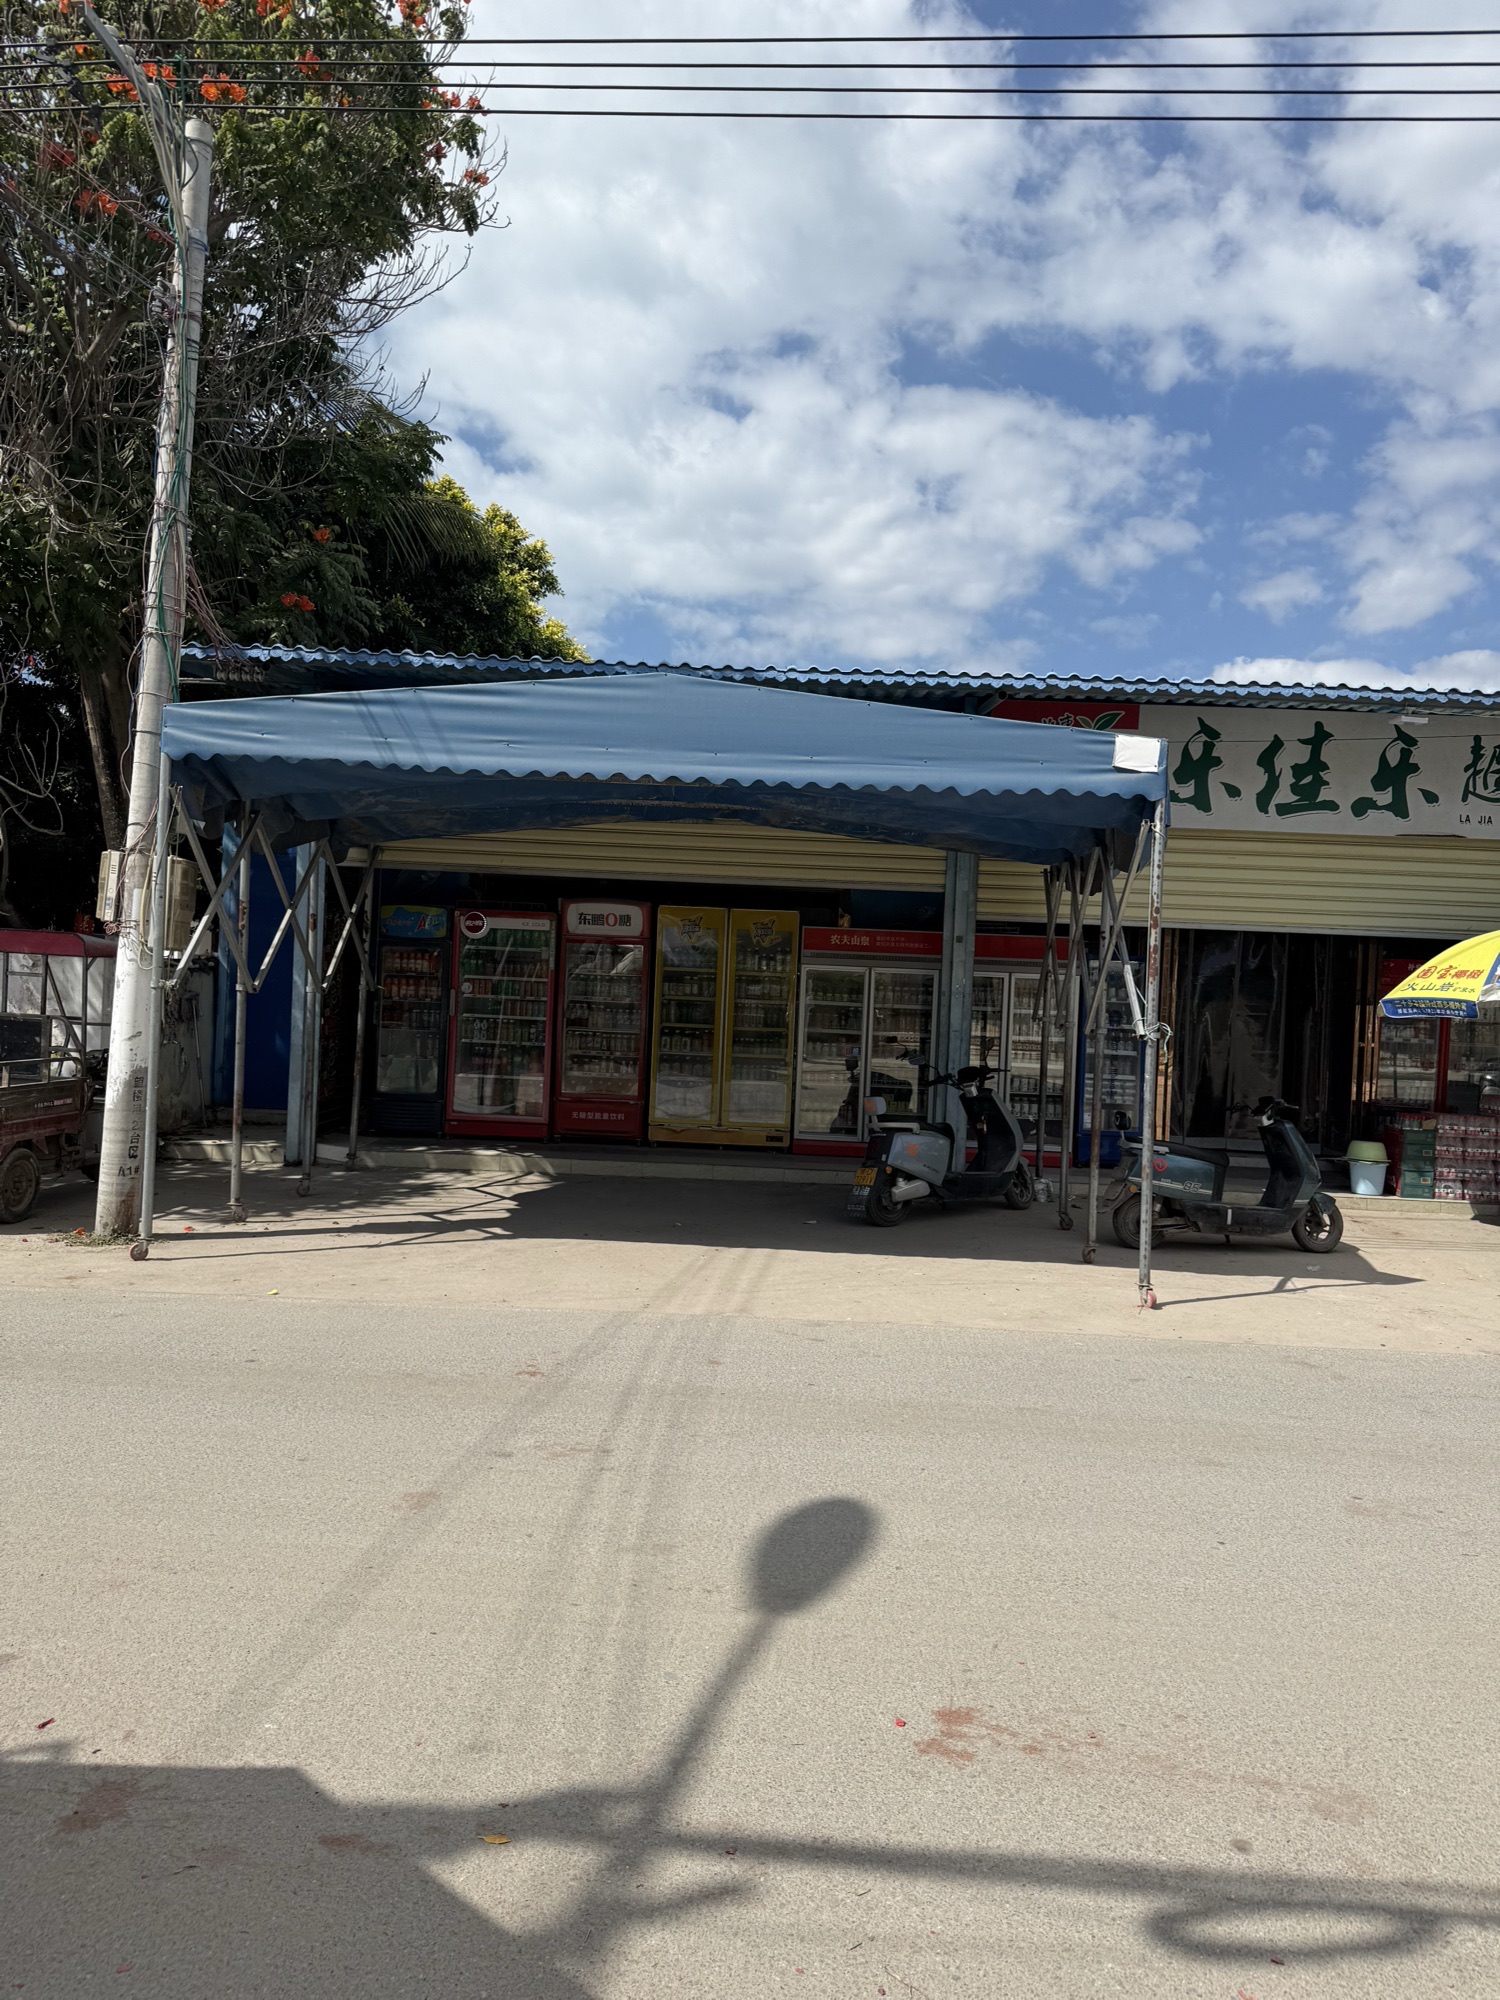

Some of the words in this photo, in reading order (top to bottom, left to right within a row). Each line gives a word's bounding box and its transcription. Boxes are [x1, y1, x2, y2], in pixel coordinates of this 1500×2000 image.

[1459, 814, 1471, 824] LA
[1477, 815, 1493, 825] JIA
[830, 934, 870, 946] 农夫山泉
[571, 1111, 625, 1121] 无糖型能量饮料
